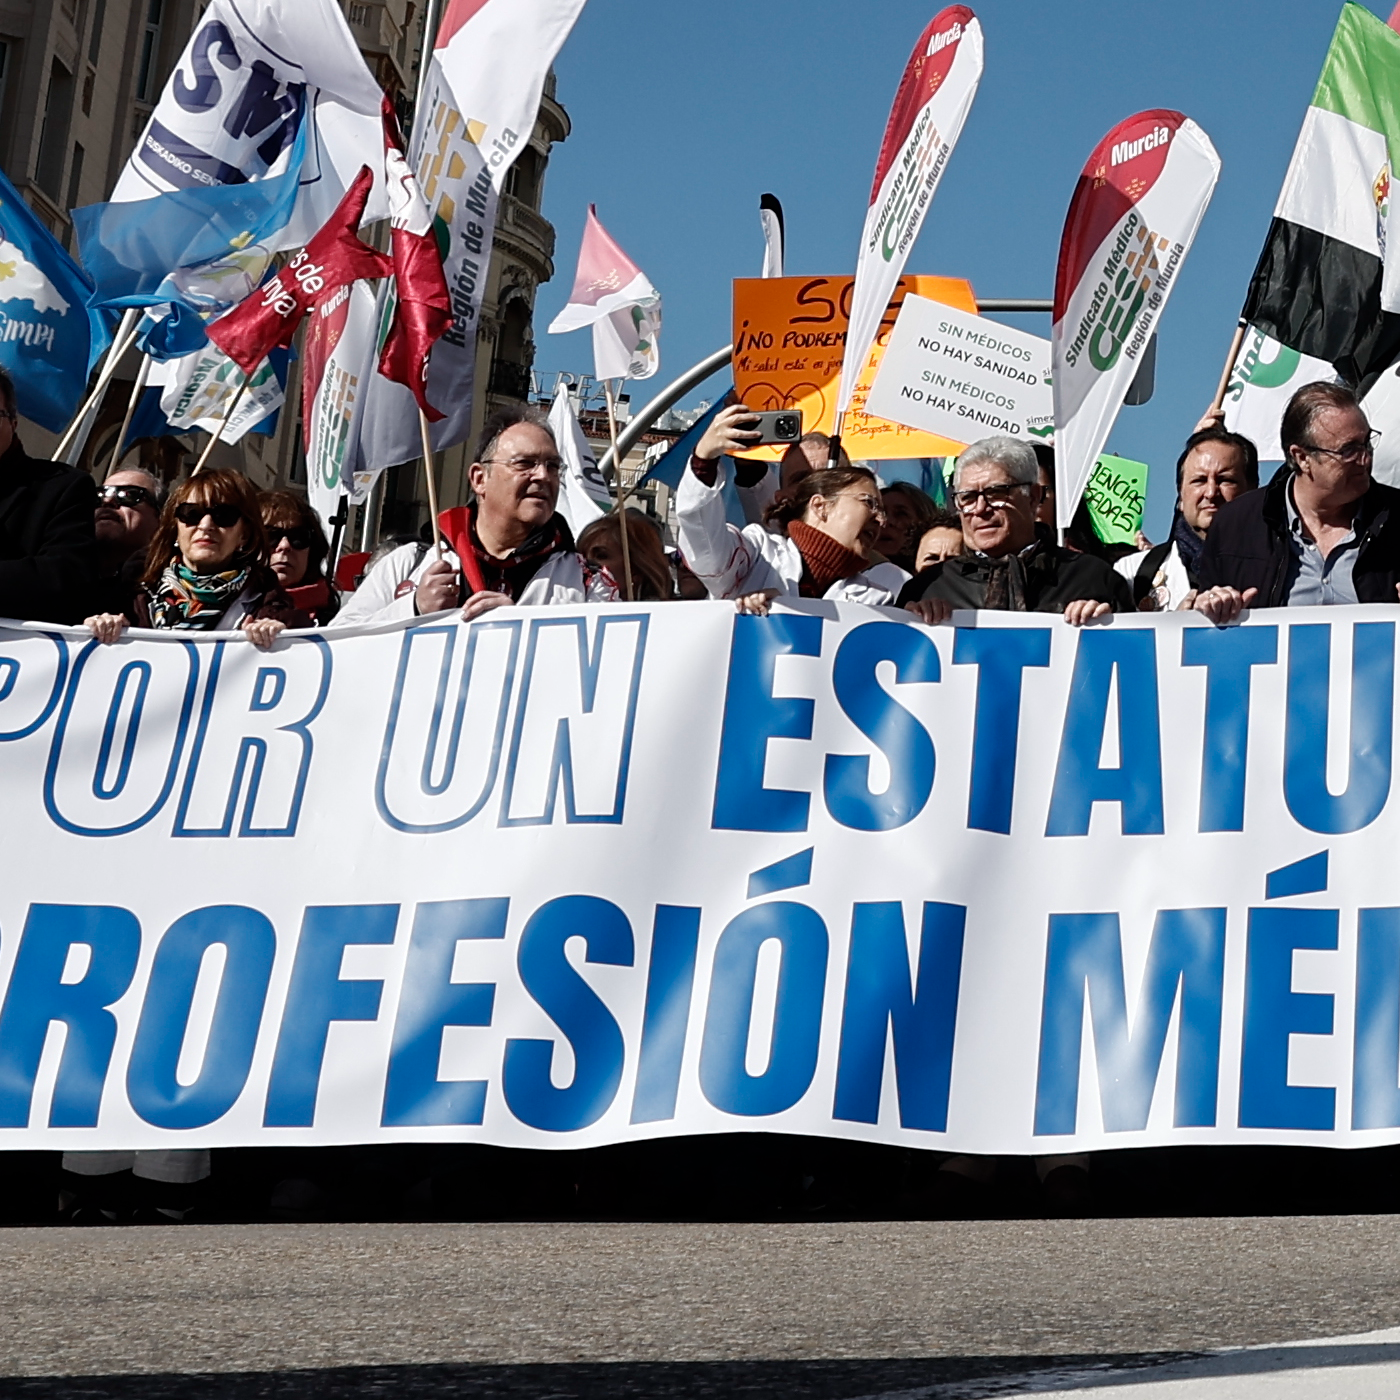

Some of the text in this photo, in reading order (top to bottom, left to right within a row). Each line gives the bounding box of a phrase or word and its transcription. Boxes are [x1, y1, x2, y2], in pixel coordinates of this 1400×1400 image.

[926, 22, 962, 57] Murcia
[1110, 126, 1170, 167] Murcia
[869, 106, 931, 253] Sindicato Médico
[917, 190, 929, 208] de
[925, 142, 950, 190] Murcia
[441, 126, 519, 348] Región de Murcia
[295, 263, 324, 294] de
[1064, 211, 1139, 369] Sindicato Médico
[1125, 241, 1185, 361] Región de Murcia
[918, 337, 941, 353] NO
[943, 345, 974, 363] HAY
[974, 355, 1038, 387] SANIDAD
[938, 322, 1033, 363] SIN MÉDICOS
[901, 386, 1021, 436] NO HAY SANIDAD
[921, 370, 1016, 411] SIN MÉDICOS
[374, 612, 651, 835] UN
